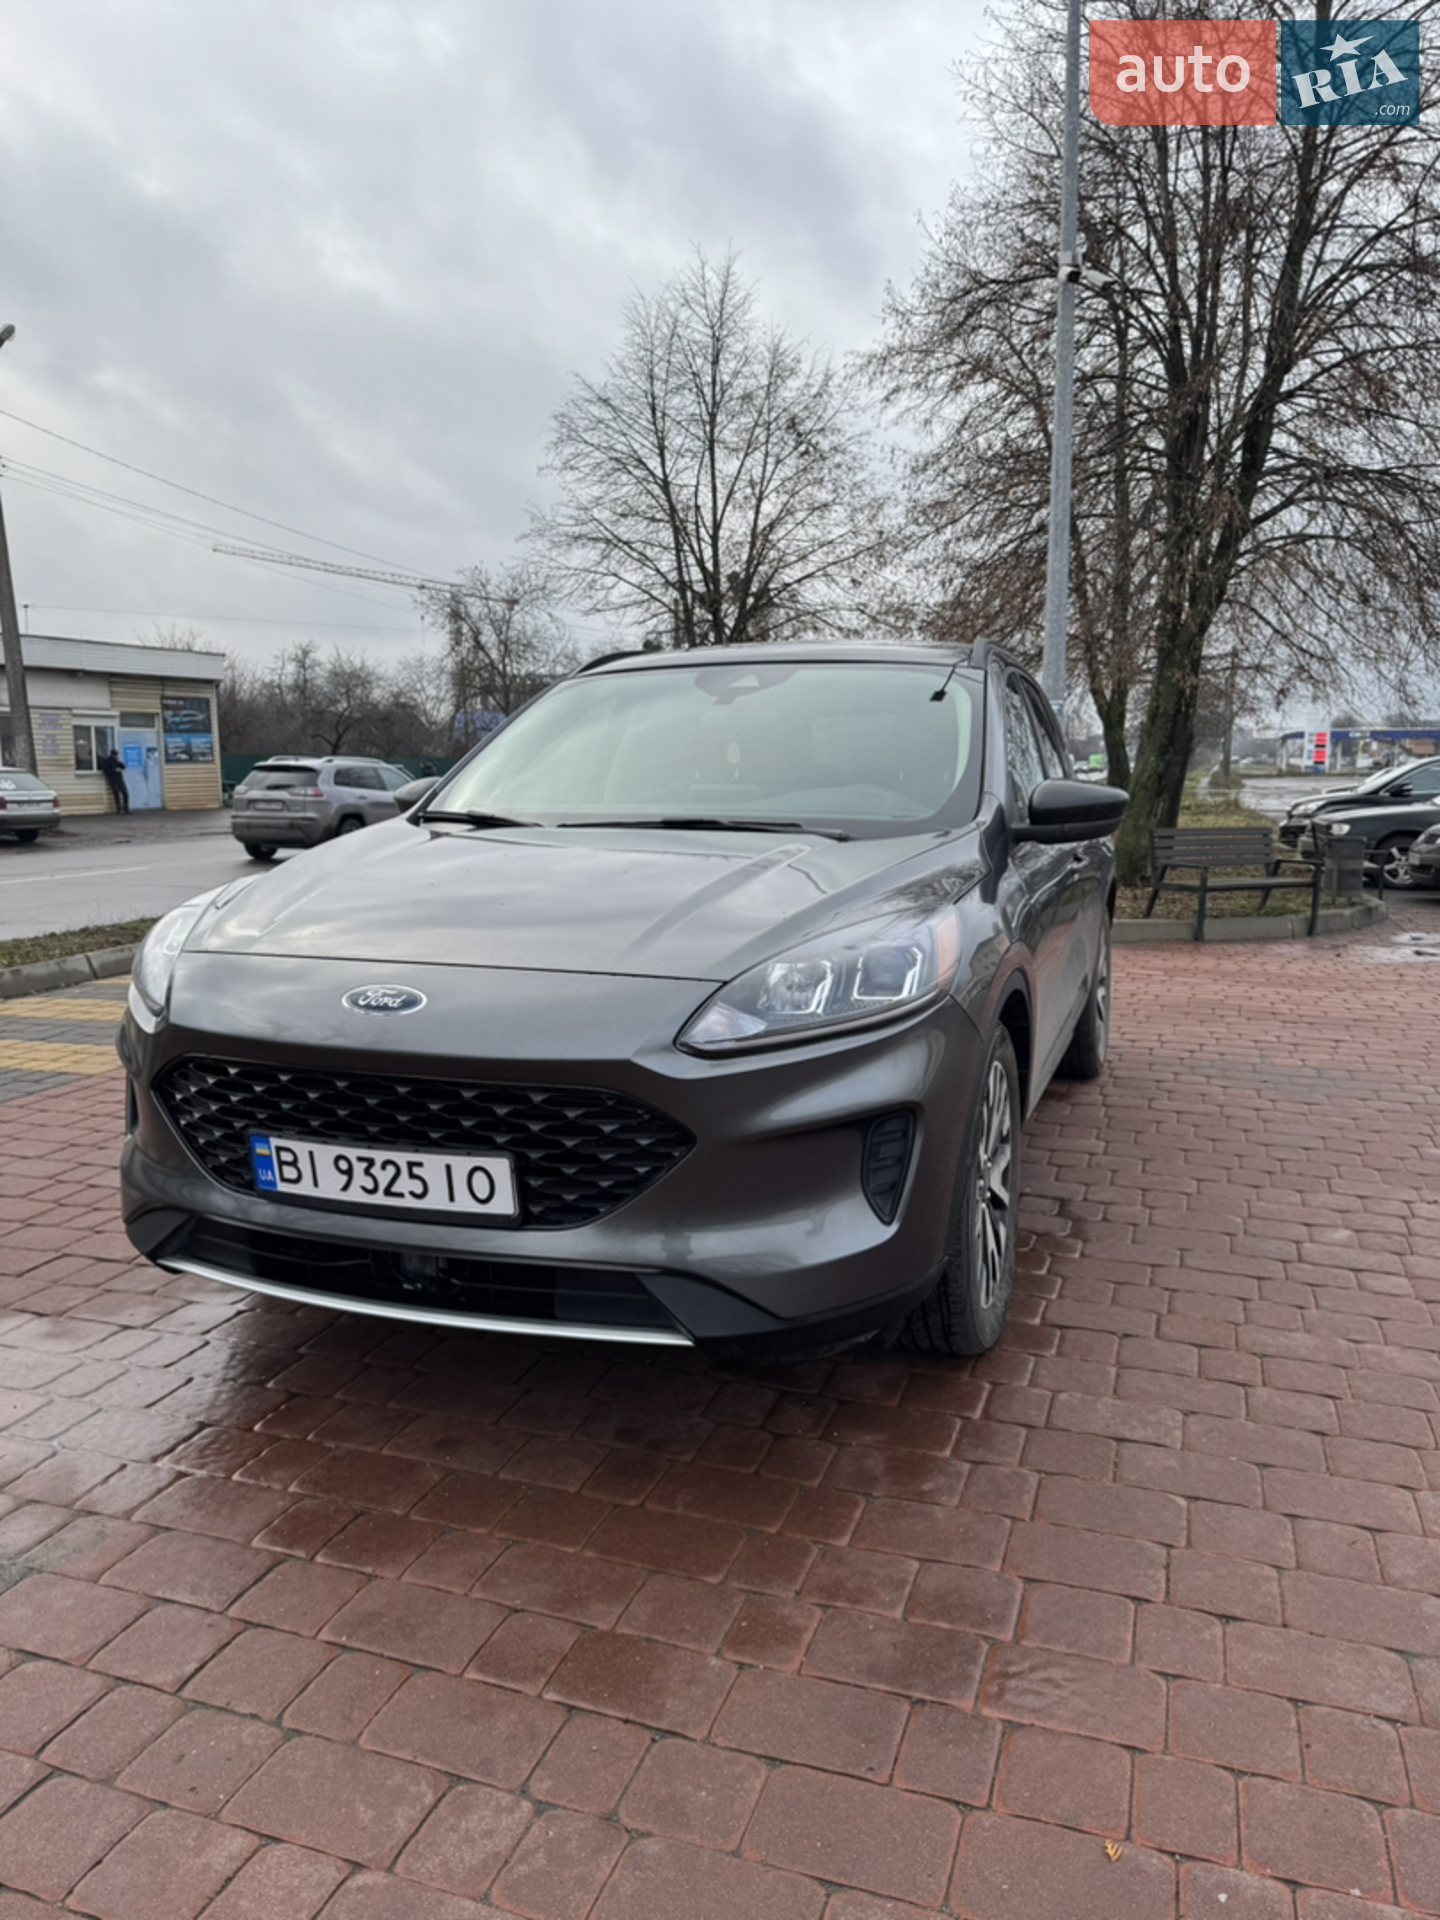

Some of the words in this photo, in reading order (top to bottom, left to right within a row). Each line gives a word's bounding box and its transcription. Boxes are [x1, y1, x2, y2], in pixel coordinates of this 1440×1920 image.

[358, 988, 407, 1008] Ford
[258, 1169, 275, 1182] UA
[274, 1145, 319, 1188] BI
[333, 1154, 429, 1200] 9325
[445, 1163, 495, 1205] IO
